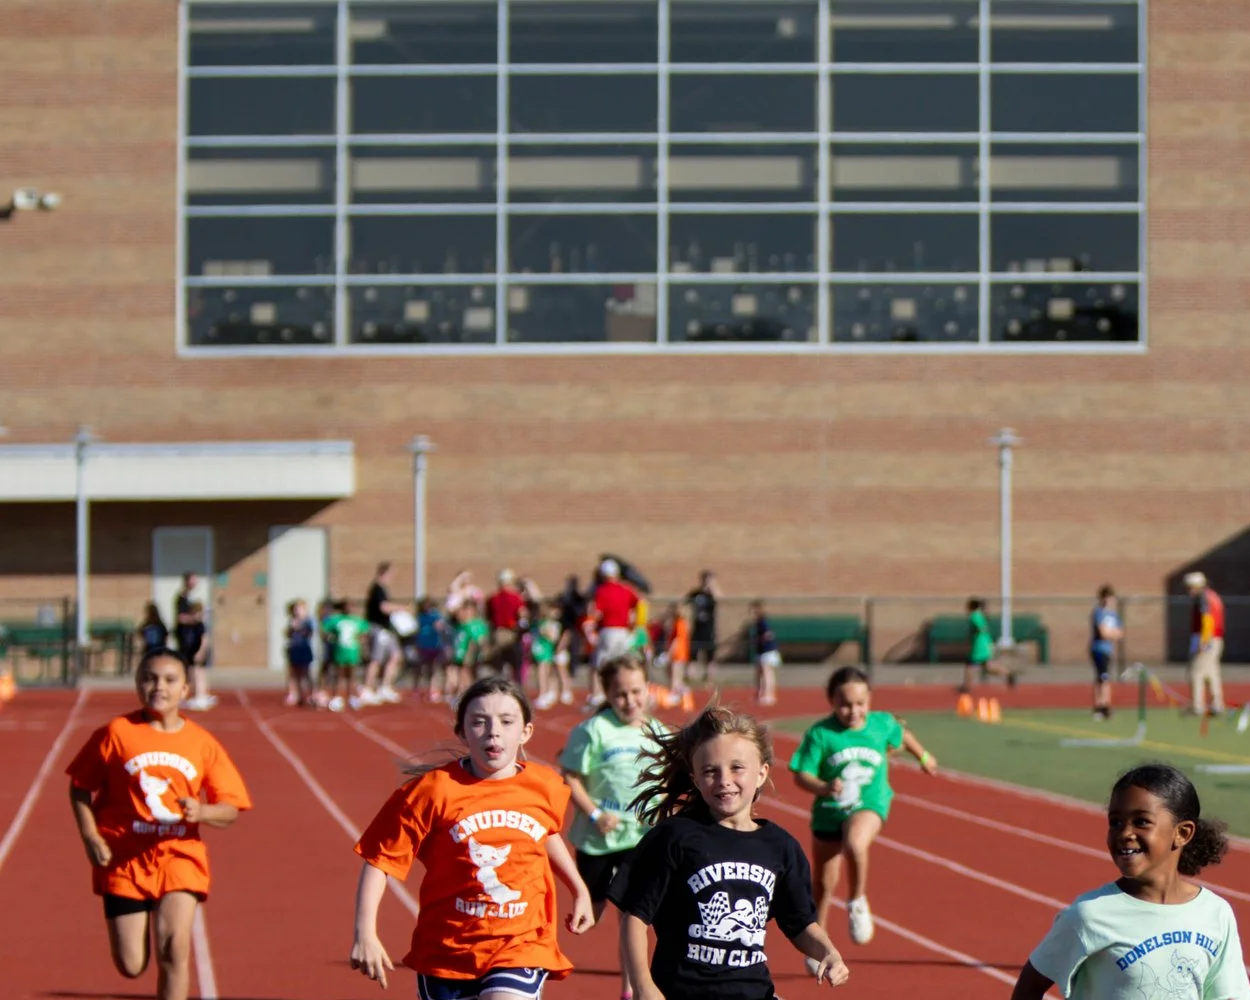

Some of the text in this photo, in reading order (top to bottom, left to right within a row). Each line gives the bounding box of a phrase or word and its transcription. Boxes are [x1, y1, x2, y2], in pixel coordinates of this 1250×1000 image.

[449, 809, 547, 843] KNUDSEN
[687, 943, 727, 965] RUN
[1116, 931, 1193, 971] DONELSON
